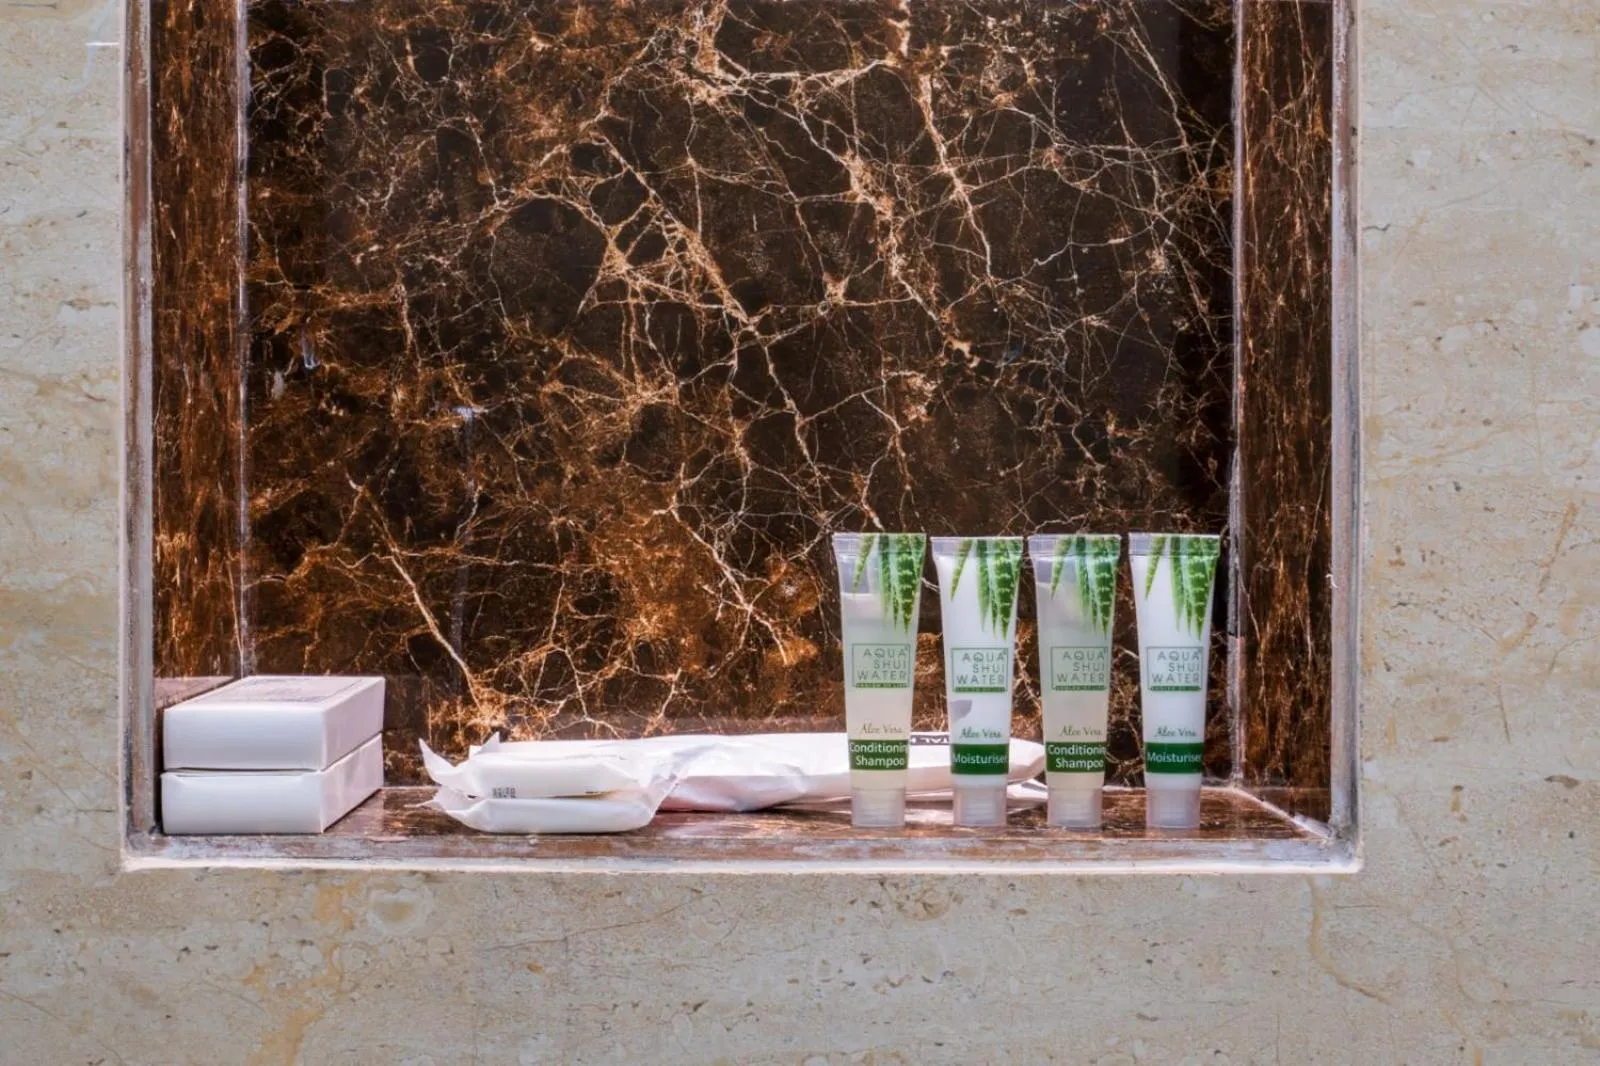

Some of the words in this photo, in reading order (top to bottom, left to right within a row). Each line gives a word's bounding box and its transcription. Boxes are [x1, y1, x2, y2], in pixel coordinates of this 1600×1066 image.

[863, 647, 906, 658] AQUA
[962, 651, 1005, 662] AQUA
[1063, 650, 1105, 661] AQUA
[1157, 650, 1200, 661] AQUA
[873, 659, 906, 670] SHUI
[972, 663, 1005, 673] SHUI
[1073, 661, 1105, 672] SHUI
[1168, 662, 1200, 673] SHUI
[857, 670, 907, 681] WATER
[956, 674, 1005, 685] WATER
[1056, 672, 1105, 683] WATER
[1152, 672, 1200, 683] WATER
[861, 722, 881, 734] Aloe
[883, 723, 903, 734] Vera
[959, 727, 980, 738] Aloe
[982, 728, 1003, 738] Vera
[1060, 725, 1081, 736] Aloe
[1083, 726, 1103, 736] Vera
[1155, 726, 1176, 737] Aloe
[1178, 728, 1198, 737] Vera
[855, 755, 905, 768] Shampoo
[1055, 757, 1104, 771] Shampoo
